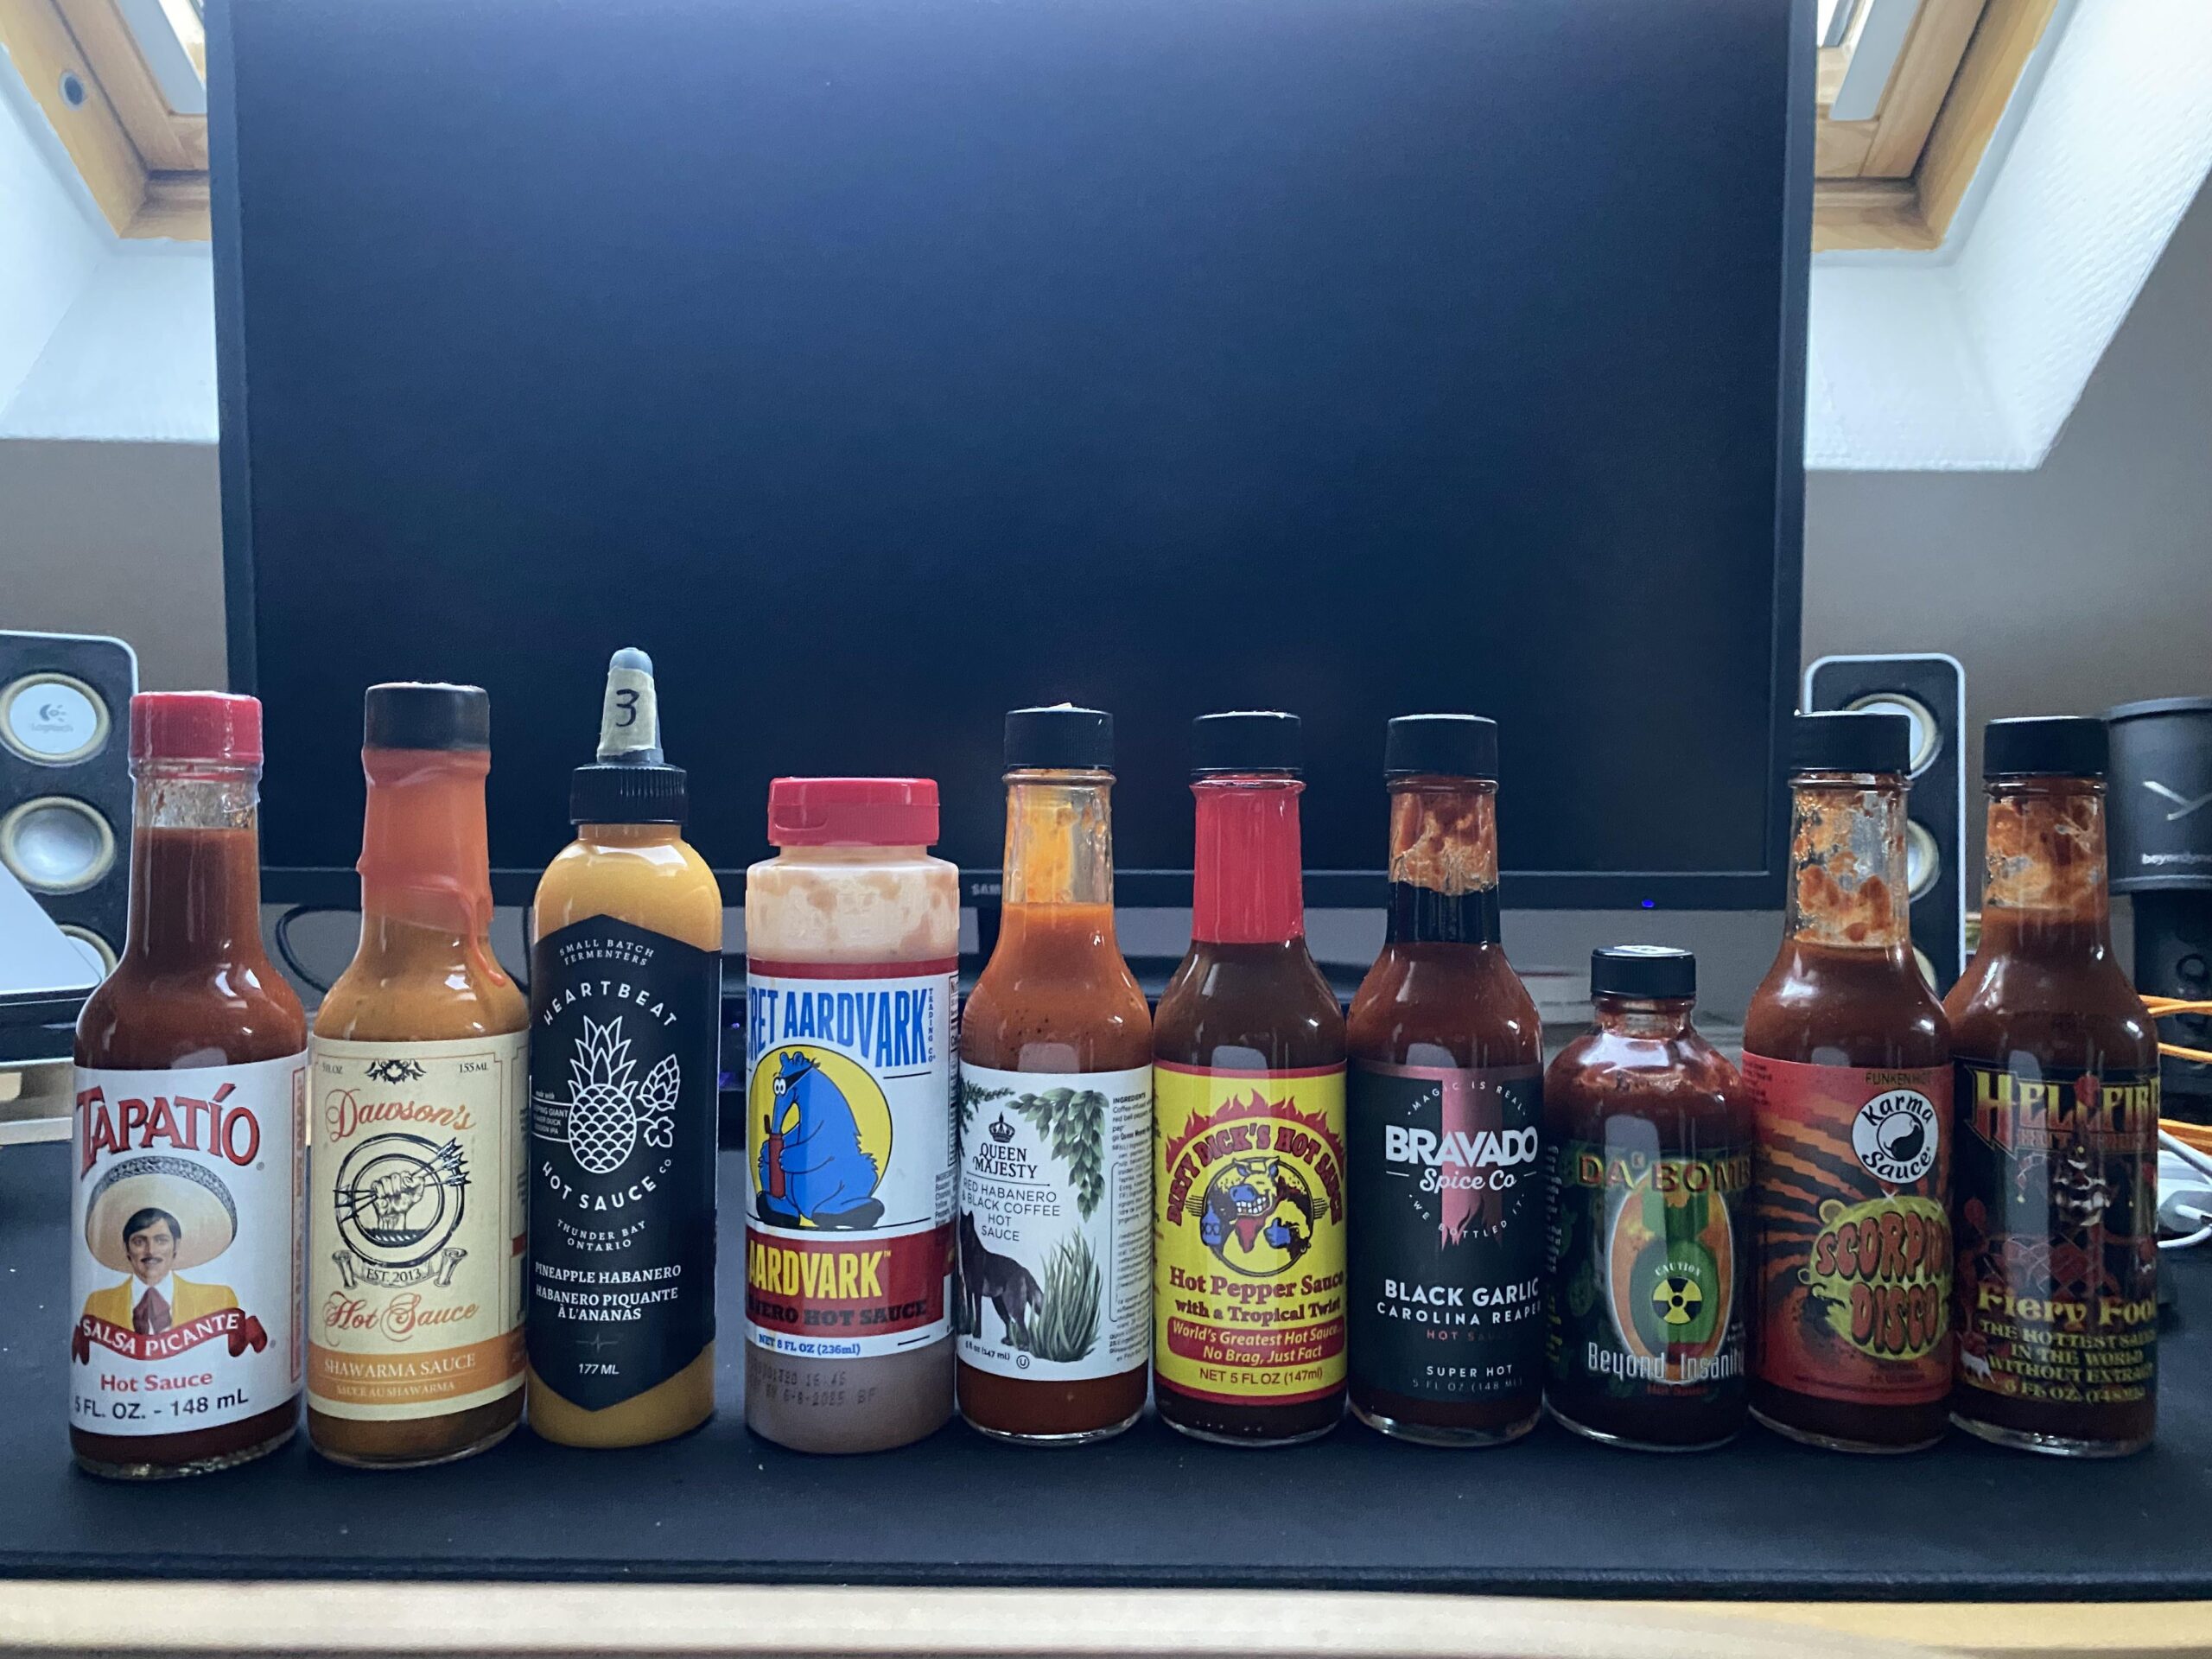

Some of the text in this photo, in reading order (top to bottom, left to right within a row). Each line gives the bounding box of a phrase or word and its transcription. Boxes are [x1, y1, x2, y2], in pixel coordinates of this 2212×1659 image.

[615, 689, 639, 727] 3
[971, 883, 1002, 896] SAM
[560, 939, 654, 957] SMALL BATCH
[564, 950, 647, 965] FERMENTERS
[543, 981, 677, 1026] HEARTBEAT
[748, 986, 927, 1069] RET AARDVARK
[1412, 1081, 1522, 1110] MAGIC IS REAL
[326, 1089, 476, 1142] Dawson's
[1865, 1093, 1935, 1127] Karma
[77, 1083, 260, 1180] TAPATÍO
[980, 1142, 1027, 1162] QUEEN
[1385, 1124, 1538, 1167] BRAVADO
[973, 1156, 1038, 1179] MAJESTY
[1167, 1153, 1200, 1227] DIRTY
[1192, 1122, 1270, 1167] DICK'S
[1274, 1126, 1322, 1165] HOT
[1861, 1149, 1932, 1179] Sauce
[543, 1159, 671, 1211] HOT SAUCE CO
[963, 1177, 1057, 1203] RED HABANERO
[1420, 1168, 1516, 1193] Spice Co
[968, 1192, 1000, 1211] BLACK
[1004, 1202, 1061, 1217] COFFEE
[557, 1219, 645, 1241] THUNDER BAY
[988, 1213, 1012, 1226] HOT
[1414, 1199, 1523, 1239] WE BOTTLED IT
[567, 1238, 632, 1251] ONTARIO
[982, 1225, 1020, 1241] SAUCE
[392, 1268, 422, 1283] 2013
[535, 1262, 682, 1284] PINEAPPLE HABANERO
[1169, 1266, 1344, 1305] Hot Pepper Sauce
[536, 1284, 678, 1308] HABANERO PIQUANTE
[1385, 1277, 1539, 1306] BLACK GARLIC
[1978, 1282, 2087, 1323] Fiery
[324, 1291, 478, 1346] Hot Sauce
[558, 1304, 641, 1321] À L'ANANAS
[804, 1309, 855, 1326] HOT
[860, 1300, 927, 1325] SAUCE
[1175, 1297, 1341, 1326] with a Tropical Twist
[1376, 1302, 1480, 1325] CAROLINA
[1850, 1281, 1939, 1355] DISCO
[83, 1313, 240, 1357] SALSA PICANTE
[759, 1334, 861, 1356] NET 8 FL OZ (236ml)
[1173, 1320, 1217, 1344] World's
[1220, 1332, 1281, 1346] Greatest
[1285, 1332, 1306, 1344] Hot
[1427, 1330, 1459, 1341] HOT
[1979, 1319, 2018, 1338] THE
[2023, 1330, 2117, 1349] HOTTEST
[325, 1353, 476, 1377] SHAWARMA SAUCE
[1203, 1345, 1322, 1365] No Brag, Just Fact
[1588, 1342, 1666, 1381] Beyond
[2012, 1344, 2144, 1365] IN THE WORLD
[100, 1371, 213, 1392] Hot Sauce
[578, 1363, 620, 1375] 177 ML
[1200, 1367, 1323, 1385] NET 5 FL OZ (147ml)
[1427, 1364, 1512, 1377] SUPER HOT
[1988, 1355, 2081, 1382] WITHOUT
[74, 1399, 81, 1414] 5
[83, 1401, 106, 1419] FL.
[112, 1402, 146, 1420] OZ.
[171, 1399, 208, 1416] 148
[217, 1389, 249, 1409] mL
